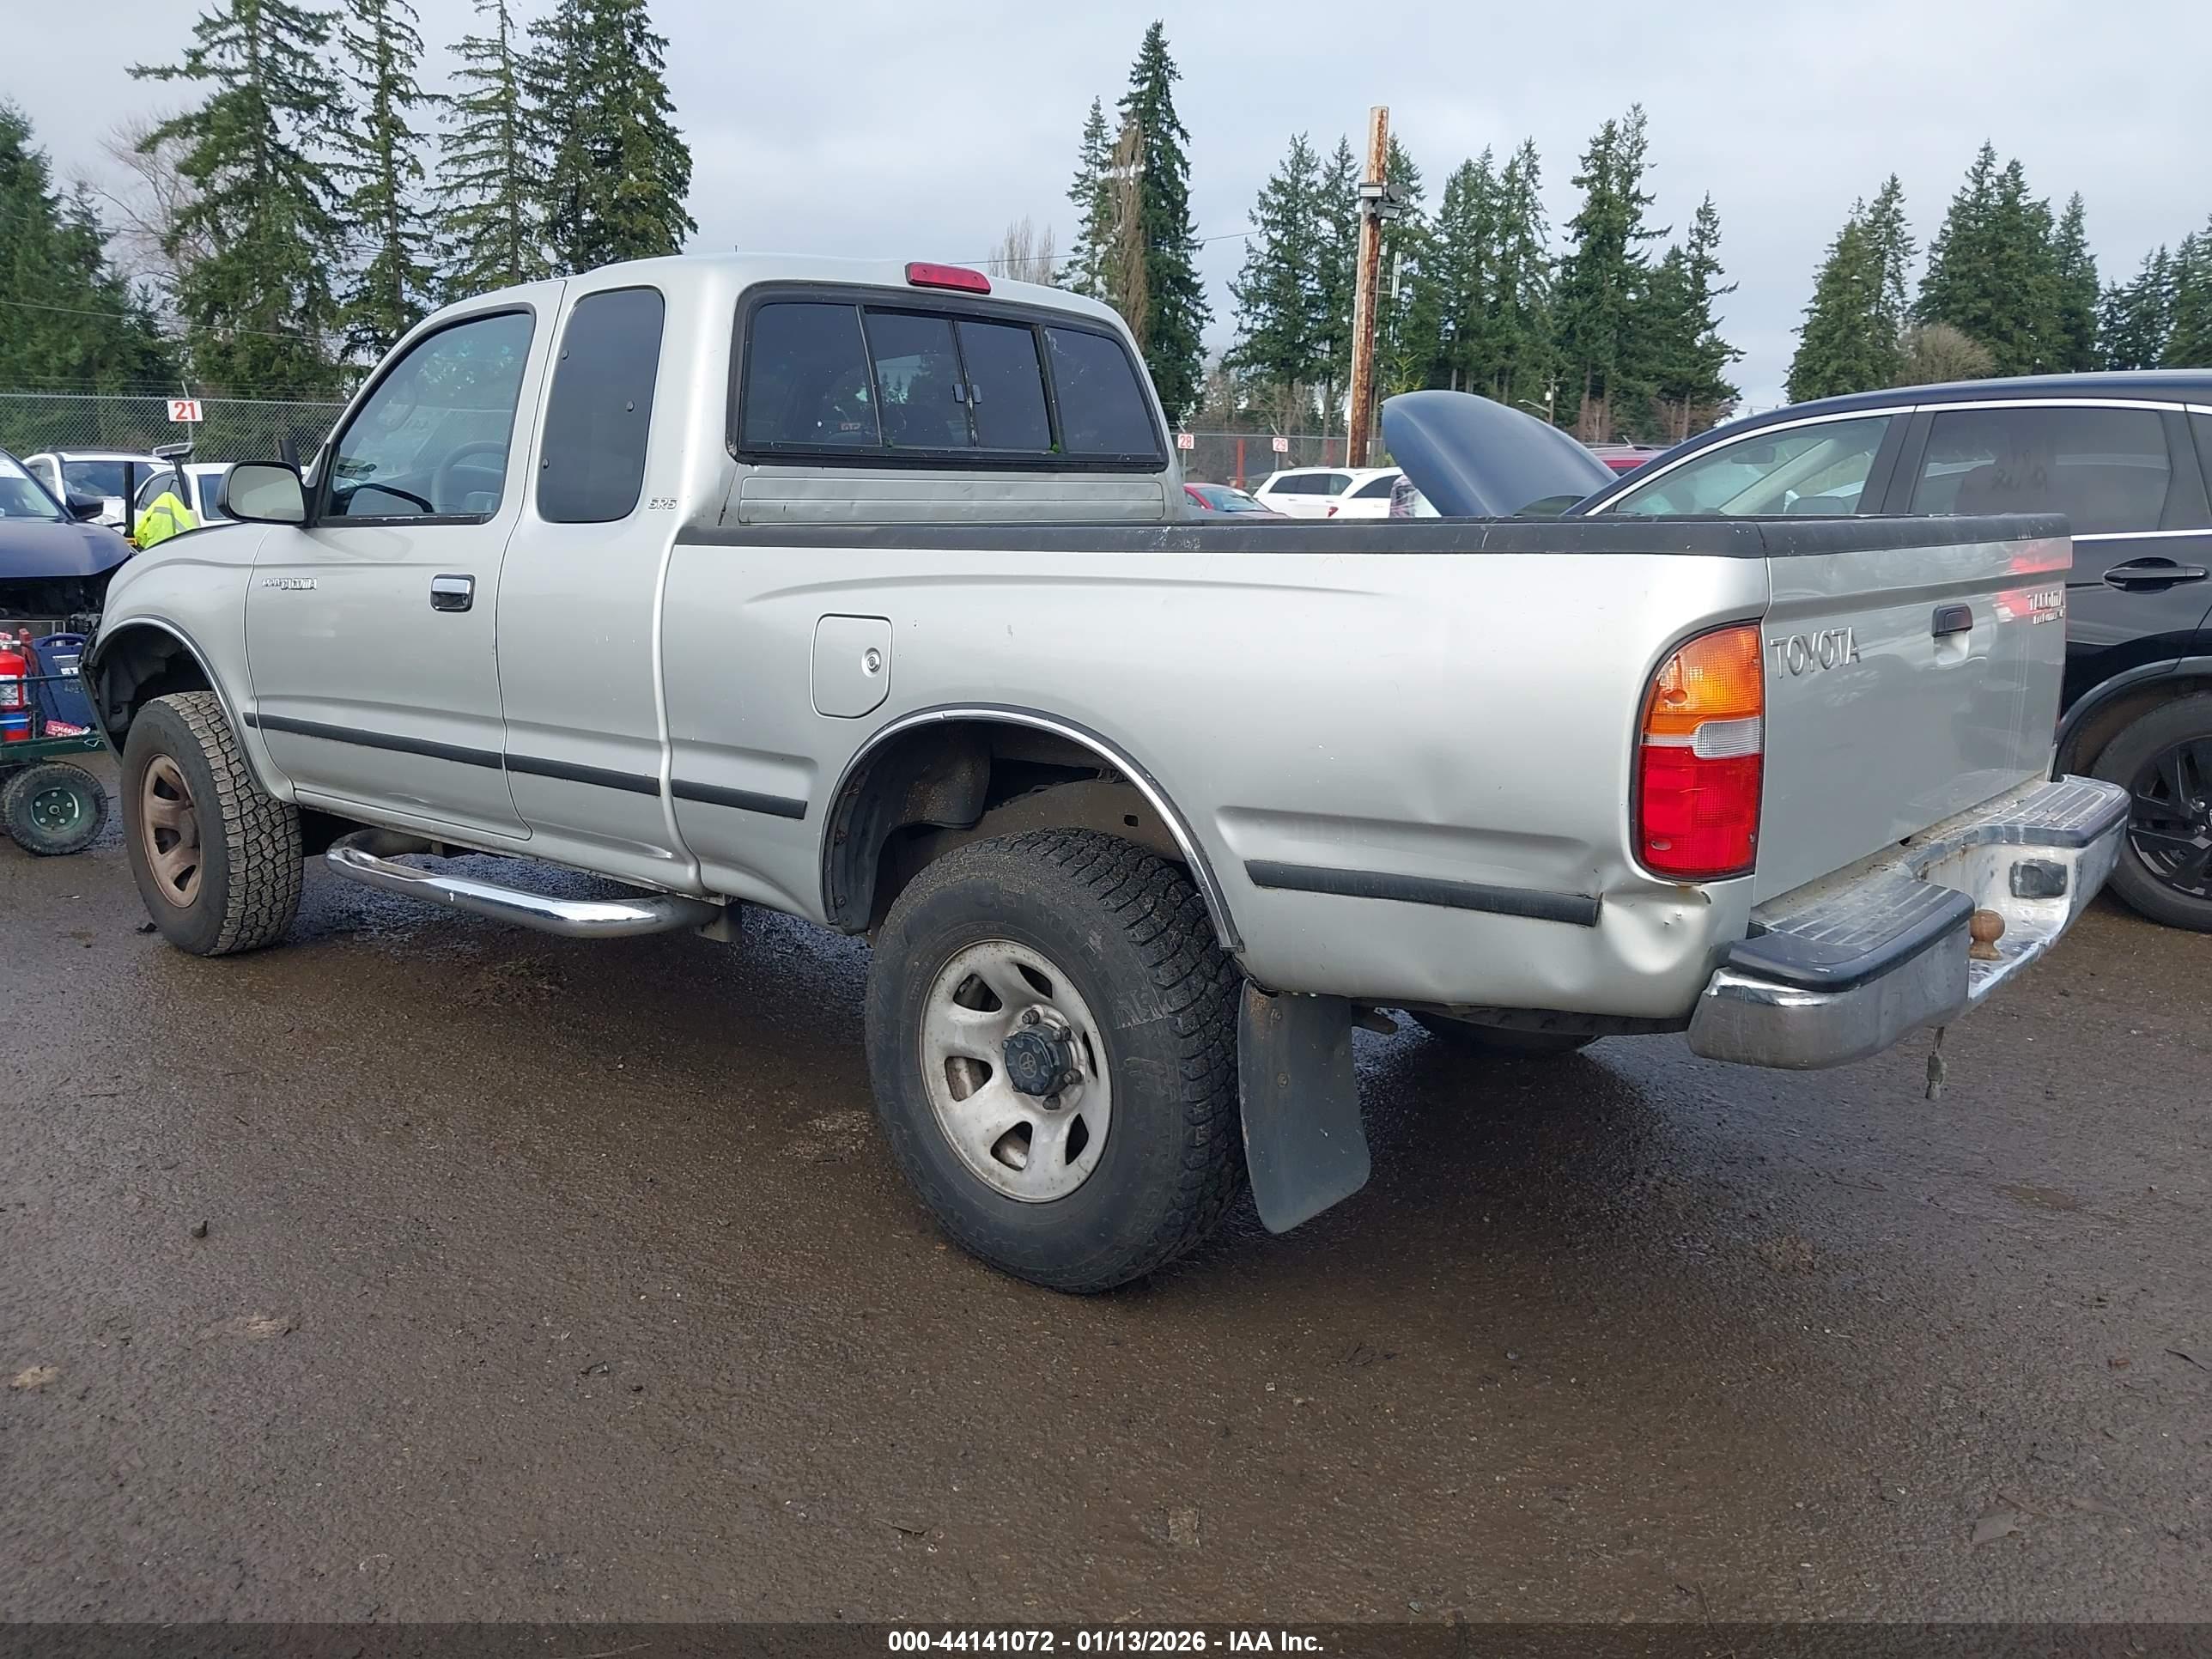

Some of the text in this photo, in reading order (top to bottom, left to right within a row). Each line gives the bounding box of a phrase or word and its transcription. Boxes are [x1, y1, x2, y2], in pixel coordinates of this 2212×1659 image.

[174, 402, 196, 420] 21
[1180, 435, 1192, 447] 28
[1274, 439, 1286, 451] 29
[1769, 625, 1861, 679] TOYOTA
